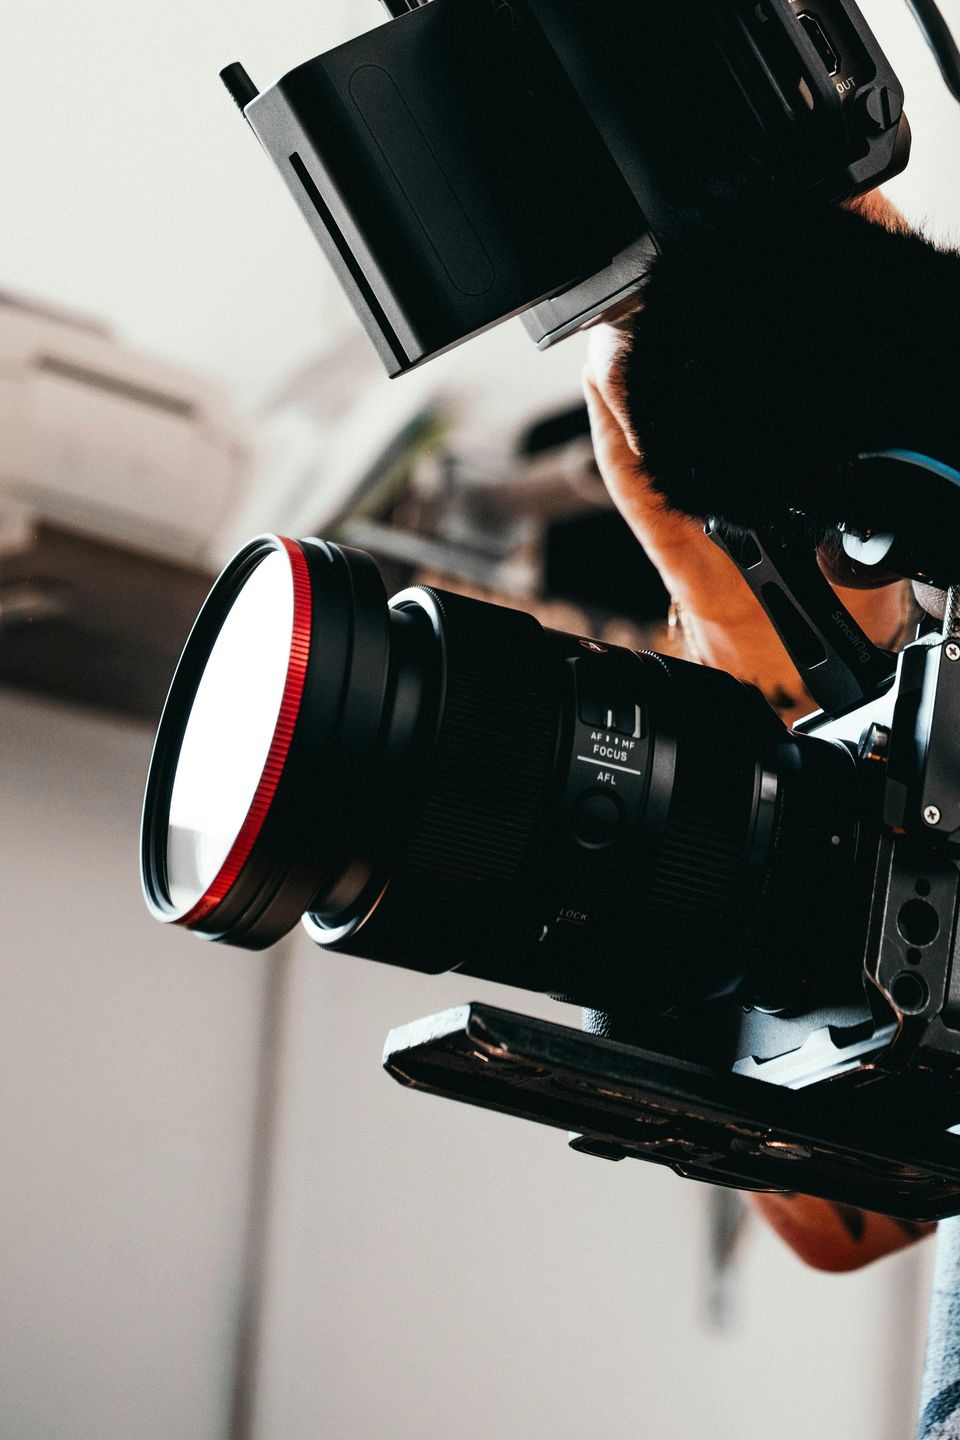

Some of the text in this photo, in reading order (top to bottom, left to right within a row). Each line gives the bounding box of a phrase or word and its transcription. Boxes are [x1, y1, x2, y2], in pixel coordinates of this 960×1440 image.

[836, 76, 856, 94] OUT
[590, 730, 636, 750] AF MF
[593, 744, 628, 762] FOCUS
[596, 771, 617, 786] AFL
[559, 907, 588, 922] LOCK
